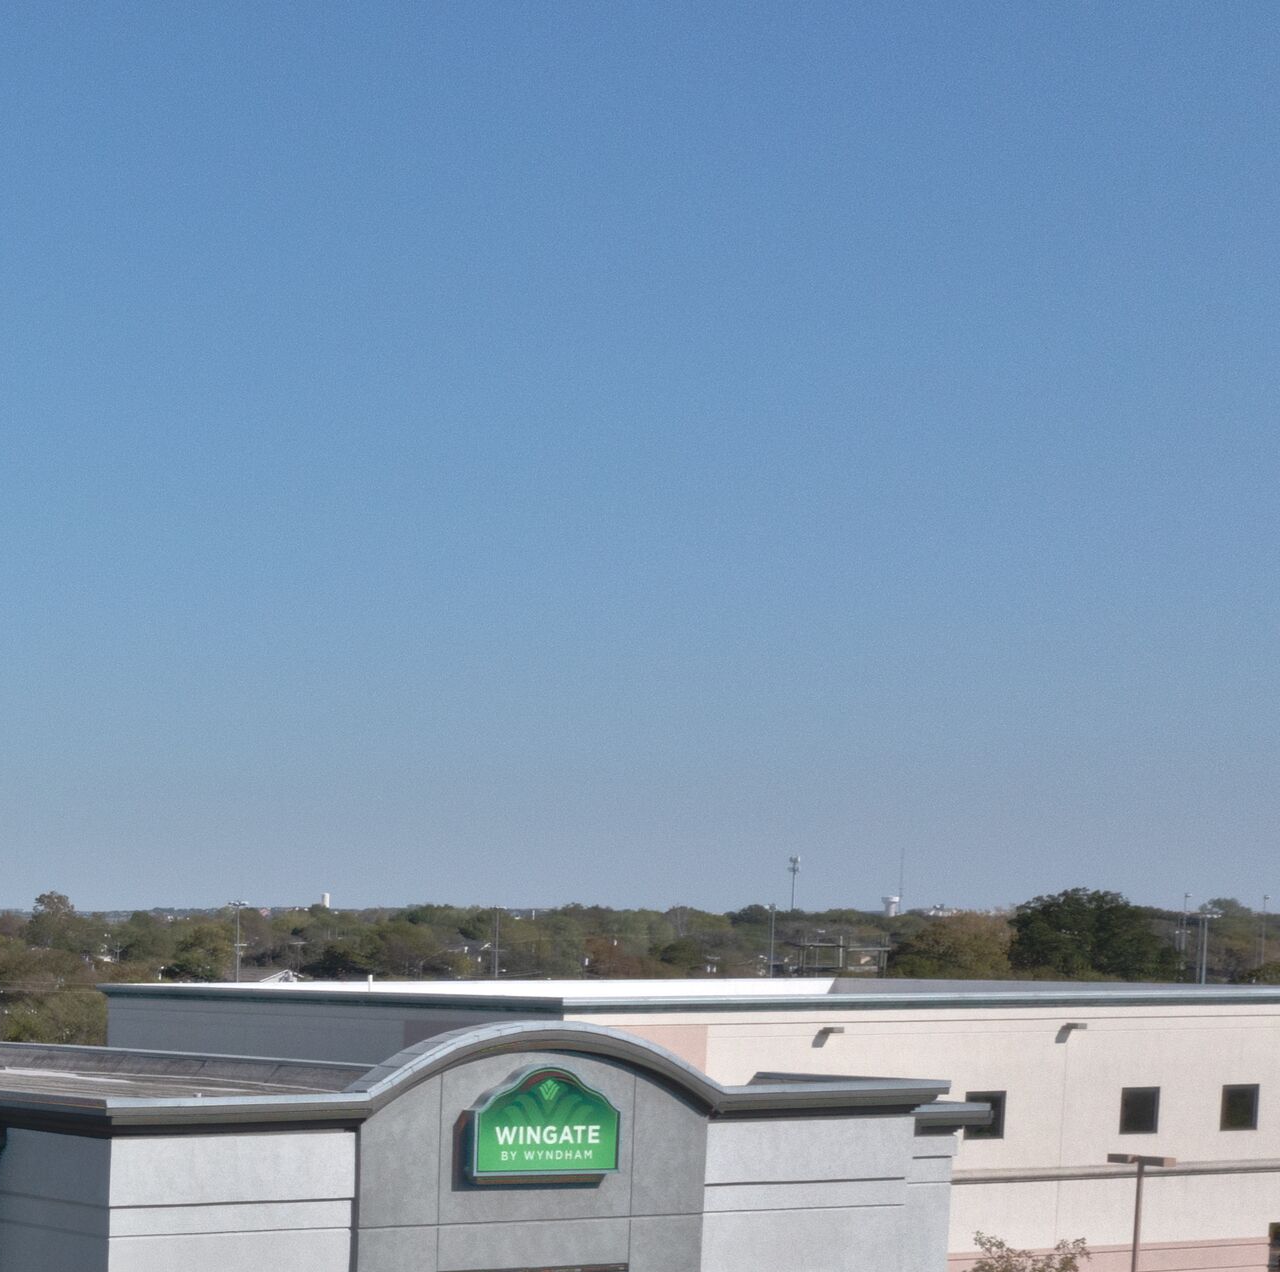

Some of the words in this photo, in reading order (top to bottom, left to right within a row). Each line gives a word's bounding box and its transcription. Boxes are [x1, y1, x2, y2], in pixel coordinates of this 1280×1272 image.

[495, 1125, 601, 1145] WINGATE
[500, 1151, 517, 1161] BY
[524, 1150, 593, 1161] WYNDHAM
